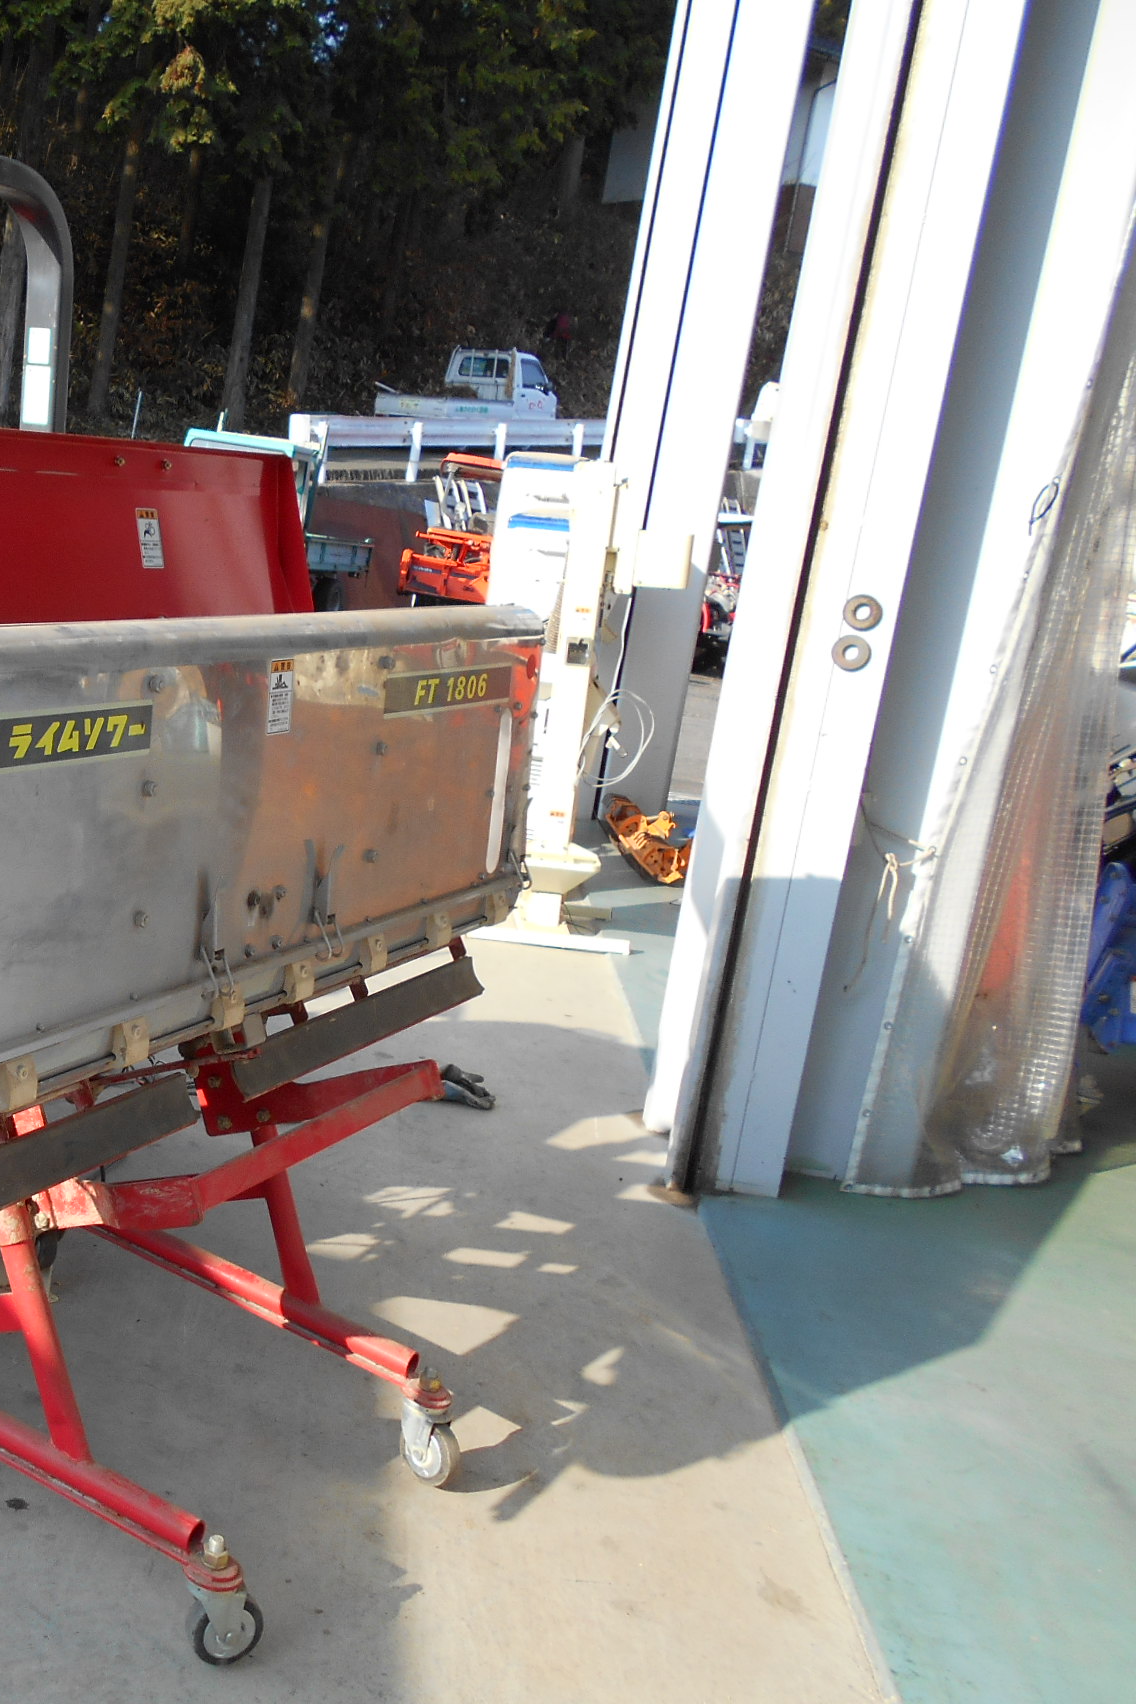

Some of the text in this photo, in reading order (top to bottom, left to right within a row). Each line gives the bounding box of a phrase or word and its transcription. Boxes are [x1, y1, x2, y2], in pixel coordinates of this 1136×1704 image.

[414, 673, 489, 706] FT 1806
[8, 714, 146, 760] ライムソワー
